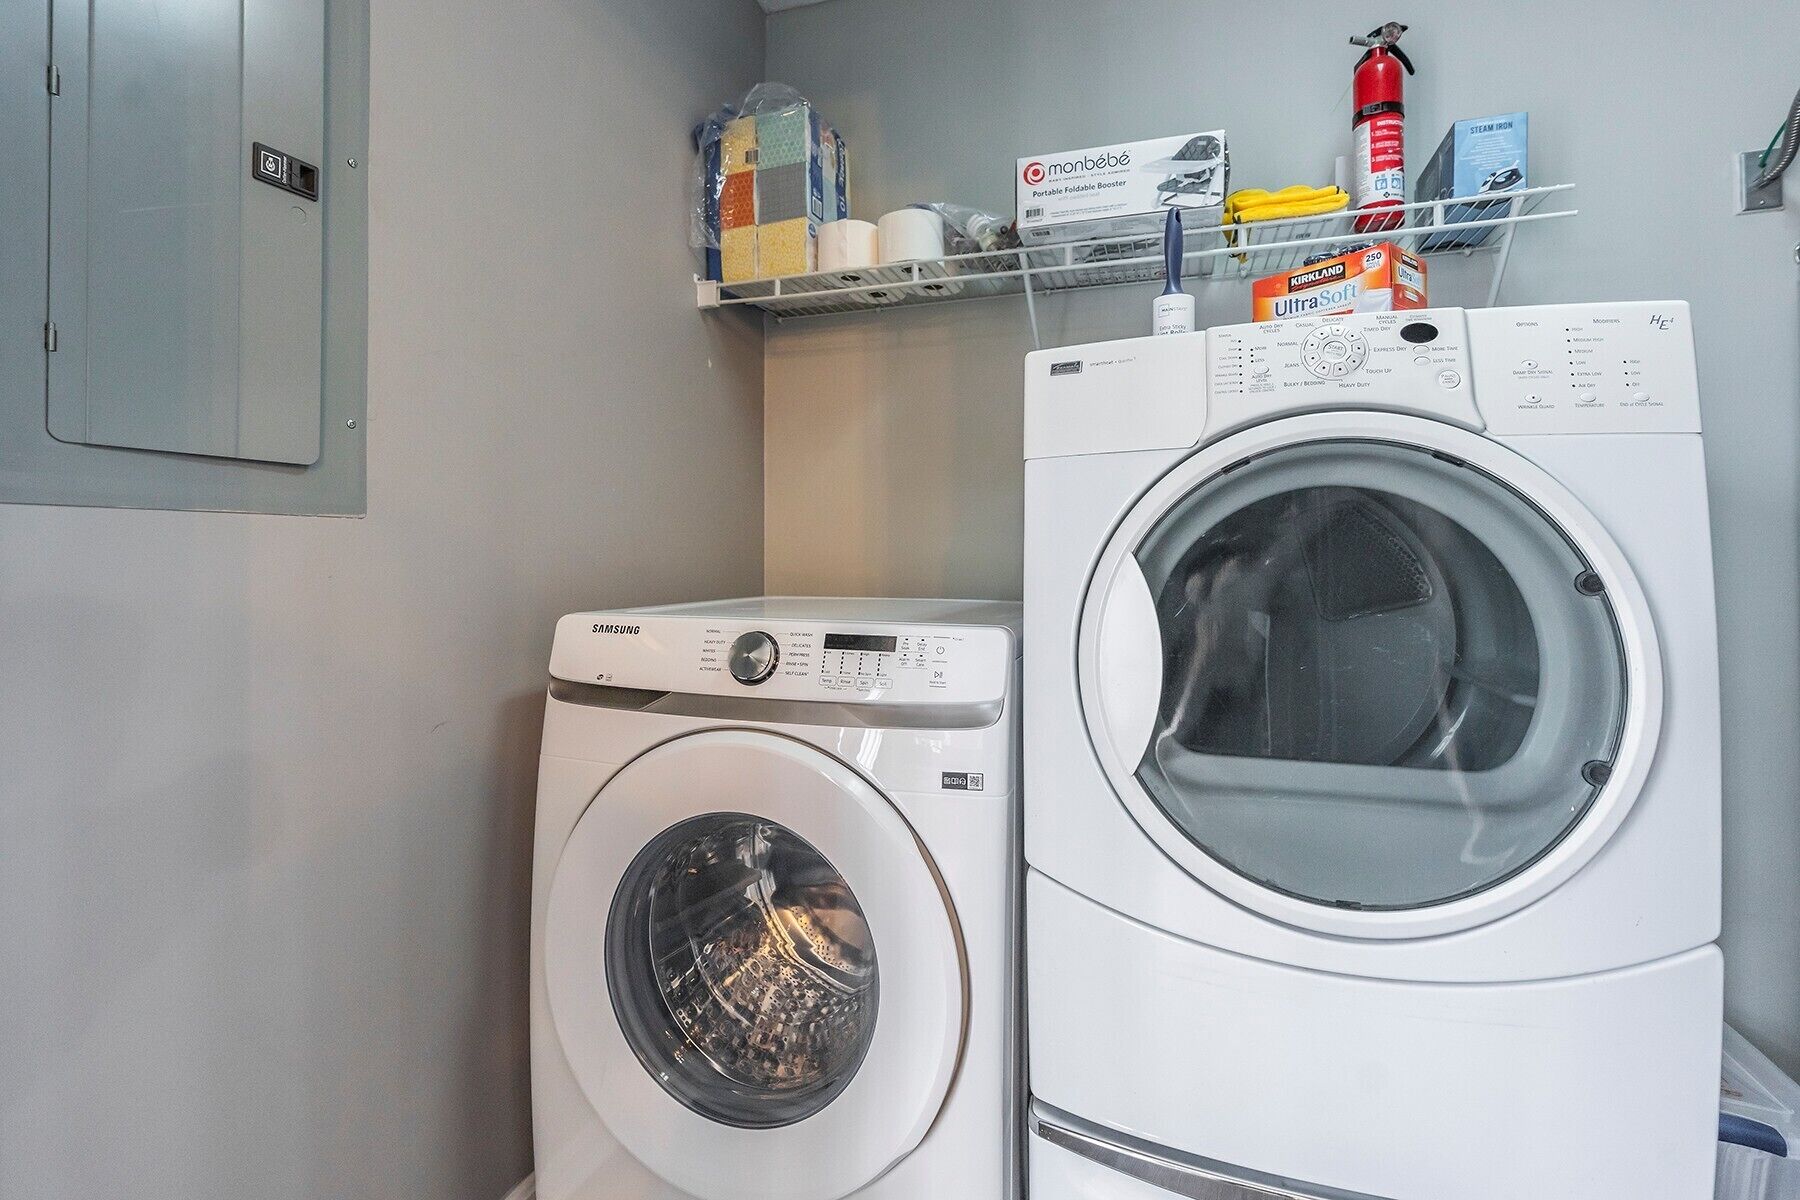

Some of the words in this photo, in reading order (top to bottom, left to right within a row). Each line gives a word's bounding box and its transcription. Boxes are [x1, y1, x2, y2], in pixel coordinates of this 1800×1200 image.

[1470, 124, 1493, 134] STEAM
[1496, 122, 1513, 130] IRON
[1048, 150, 1130, 175] monbébé
[1032, 188, 1062, 198] Portable
[1064, 184, 1095, 193] Foldable
[1098, 180, 1127, 189] Booster
[1366, 252, 1382, 262] 250
[1290, 264, 1344, 286] KIRKLAND
[592, 624, 640, 635] SAMSUNG
